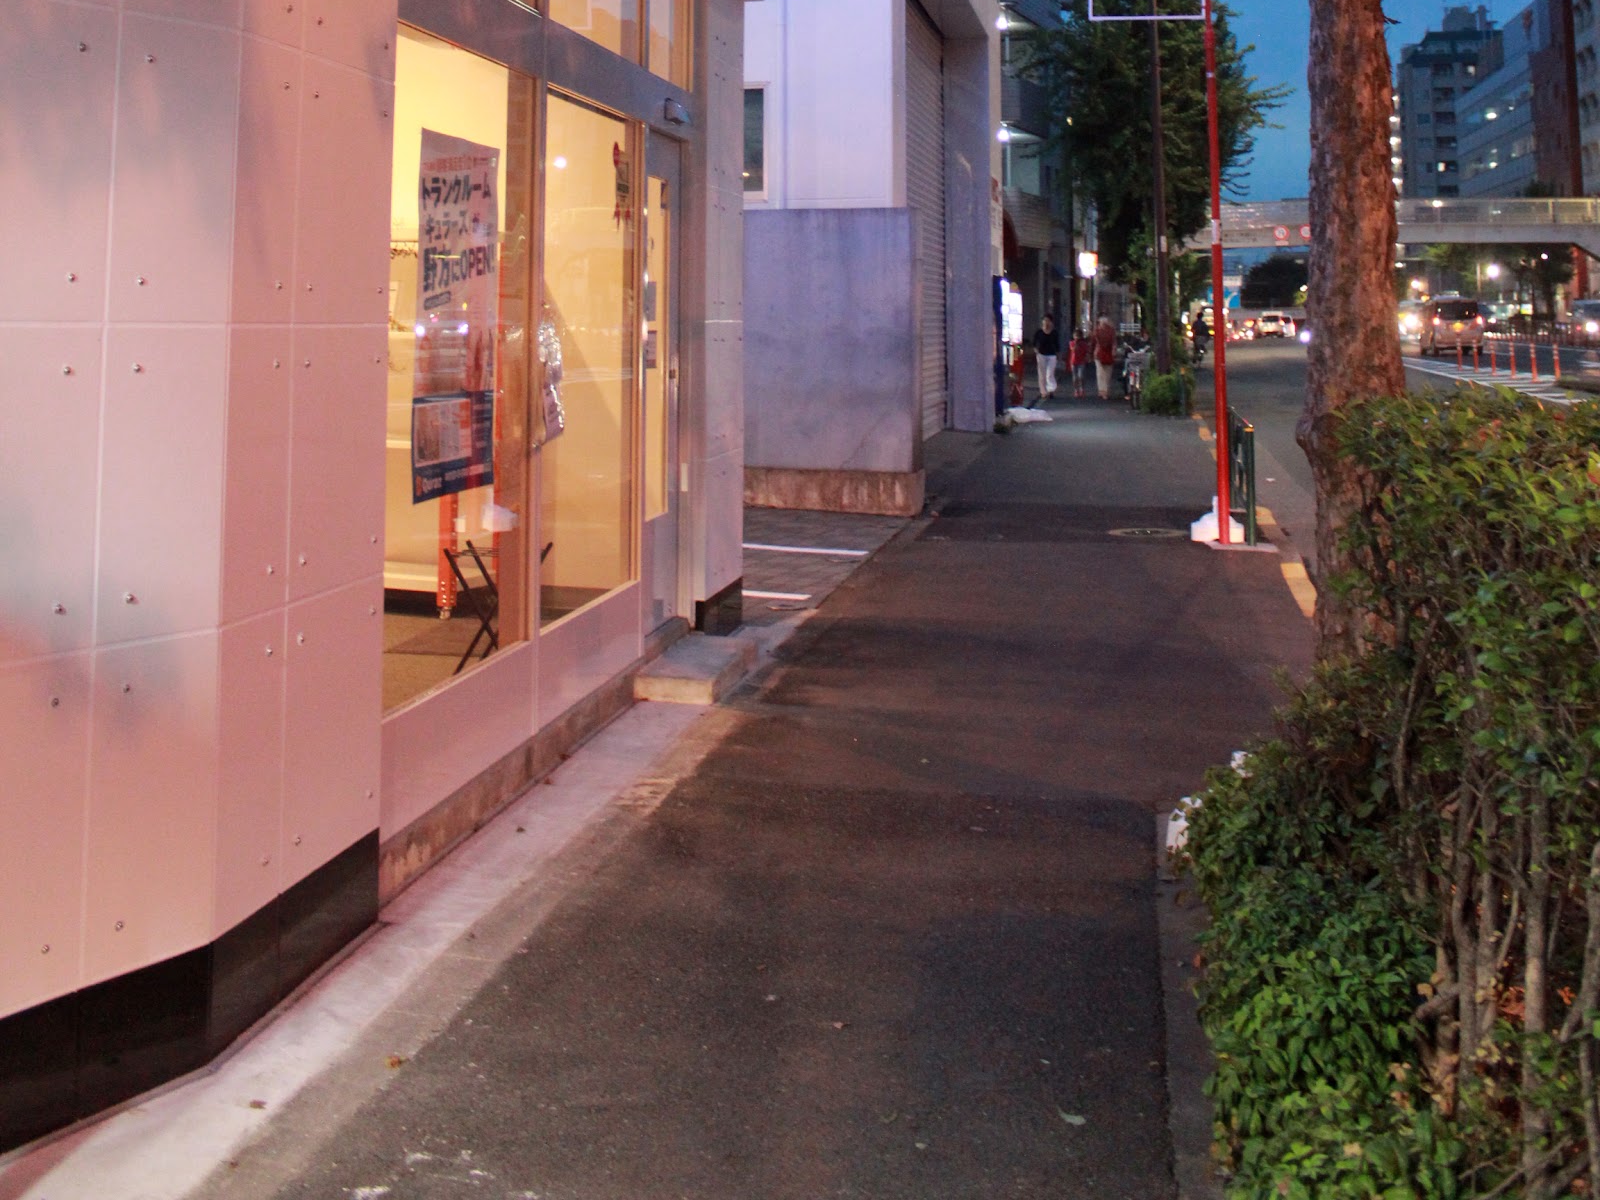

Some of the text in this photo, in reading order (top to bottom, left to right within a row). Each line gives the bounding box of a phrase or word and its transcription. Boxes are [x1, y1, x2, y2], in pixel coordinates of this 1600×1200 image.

[422, 171, 492, 211] トランクルーム
